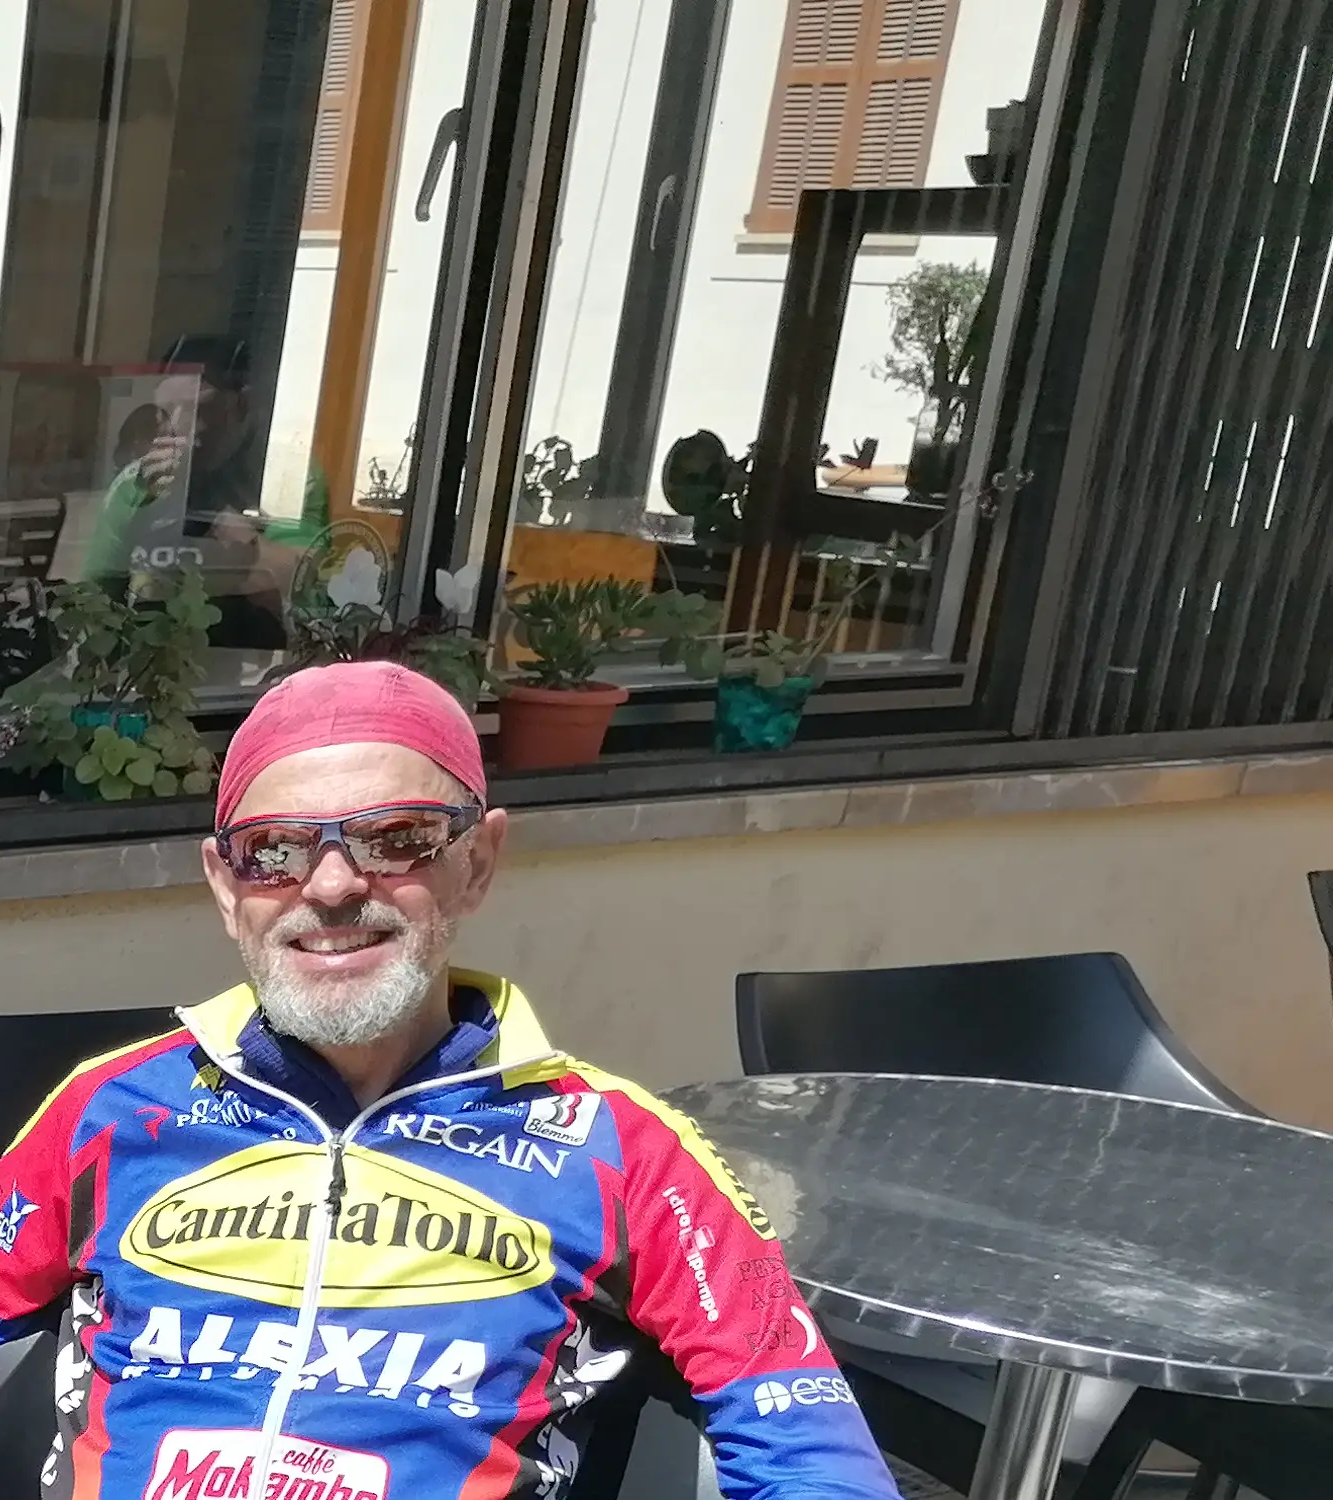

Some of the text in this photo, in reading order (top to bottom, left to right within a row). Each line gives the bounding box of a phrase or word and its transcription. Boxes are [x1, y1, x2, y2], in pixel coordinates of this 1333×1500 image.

[383, 1112, 573, 1180] REGAIN
[131, 1305, 488, 1402] ALEXIA
[283, 1446, 338, 1475] caffè
